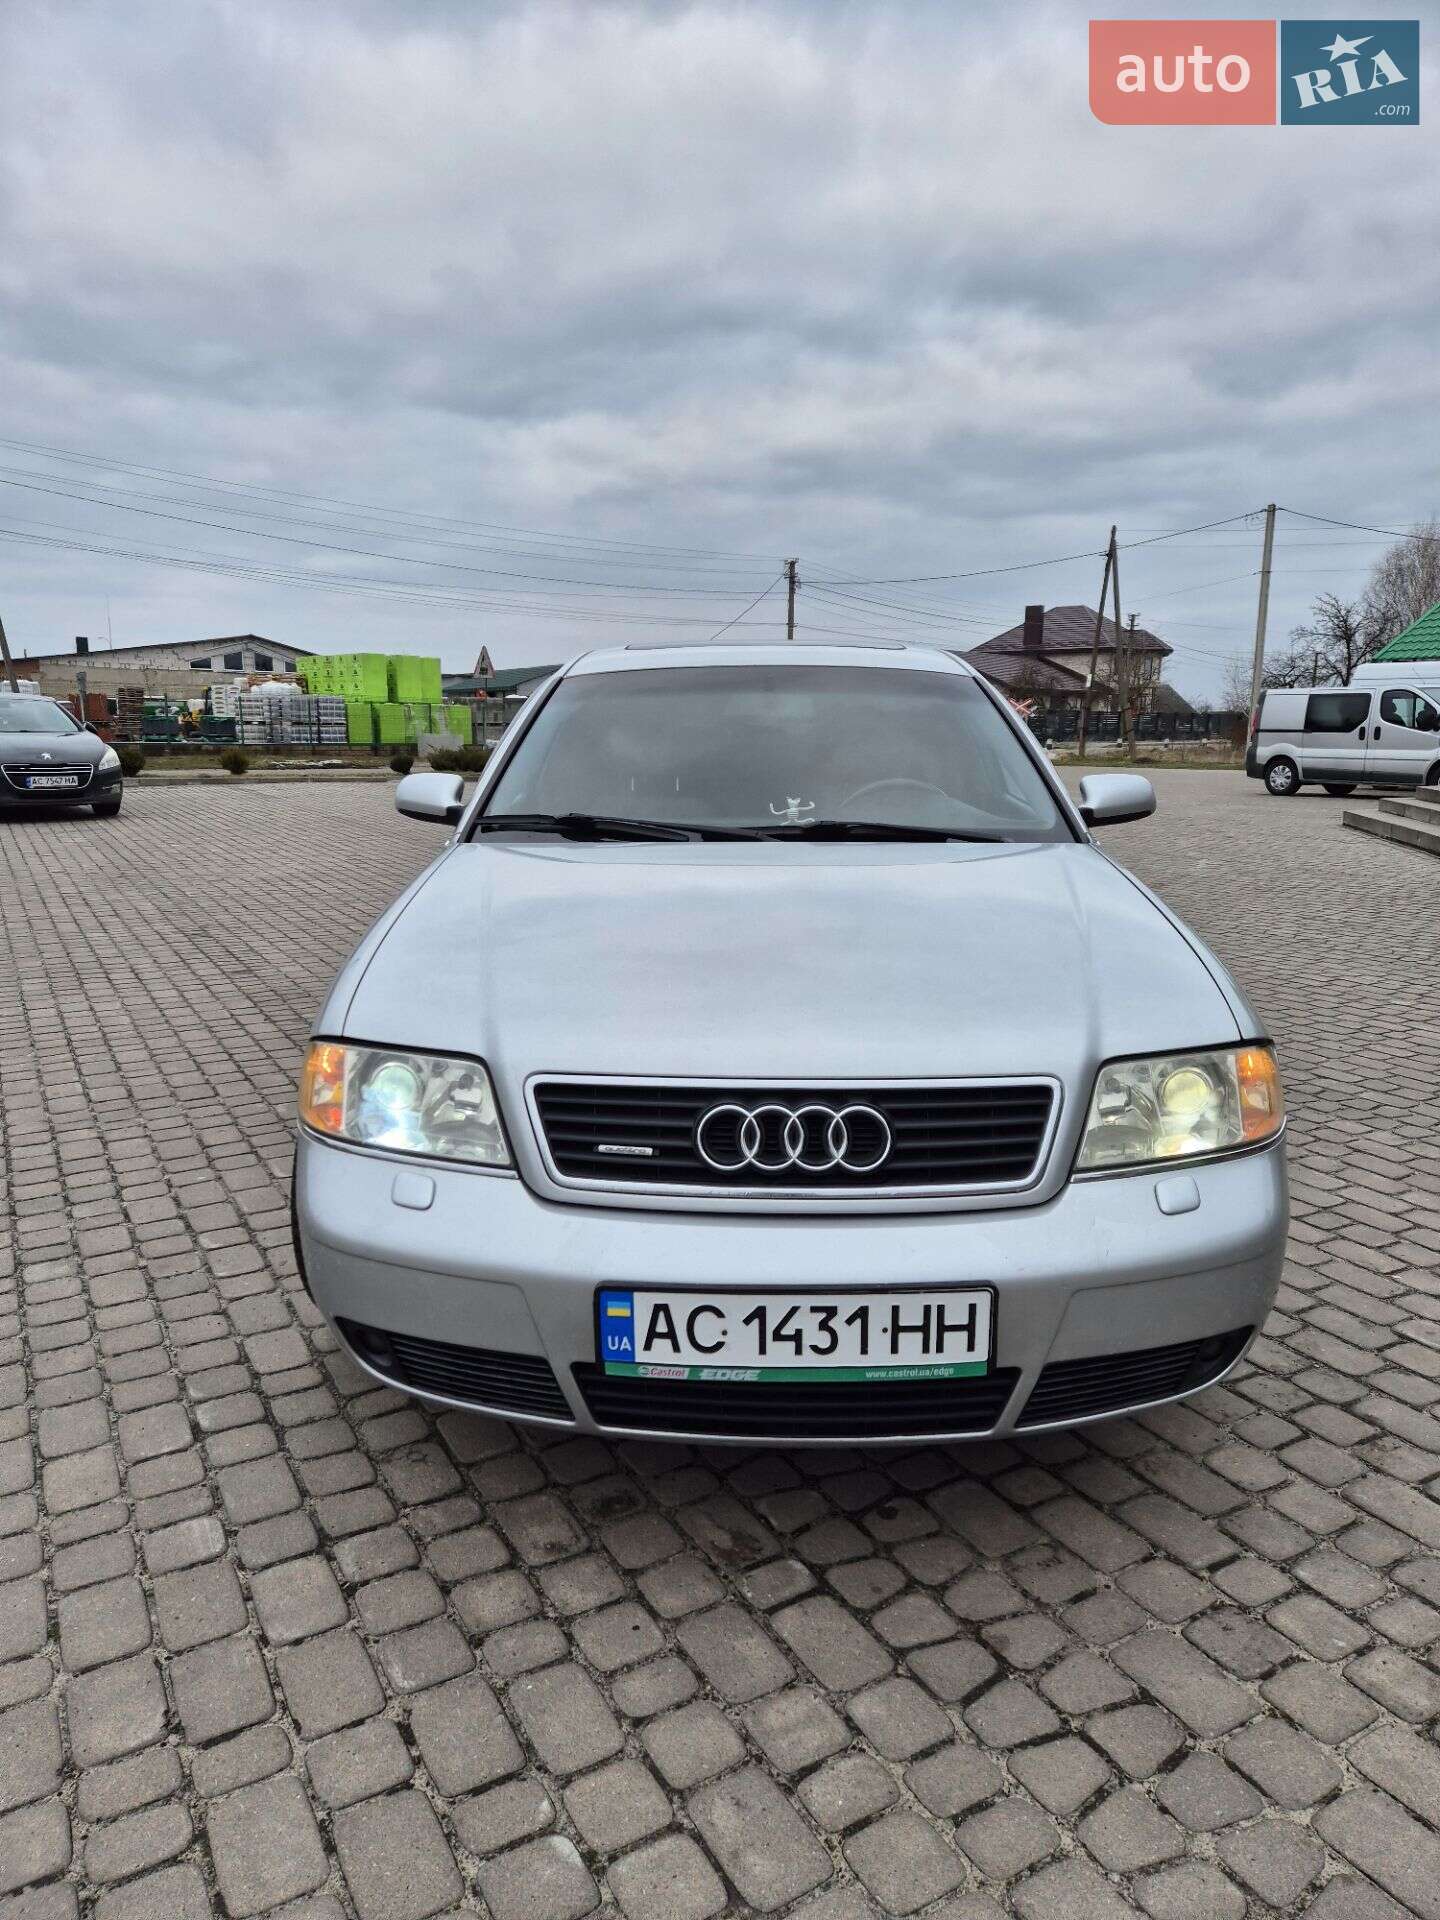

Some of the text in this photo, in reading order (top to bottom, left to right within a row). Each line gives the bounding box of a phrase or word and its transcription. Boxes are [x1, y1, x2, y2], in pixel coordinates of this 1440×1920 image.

[32, 777, 44, 785] AC
[64, 776, 77, 785] HA
[642, 1303, 977, 1356] AC 1431 HH
[607, 1335, 632, 1351] UA
[650, 1366, 762, 1381] Castrol EDGE
[865, 1367, 955, 1379] www.castrol.ua/edge
